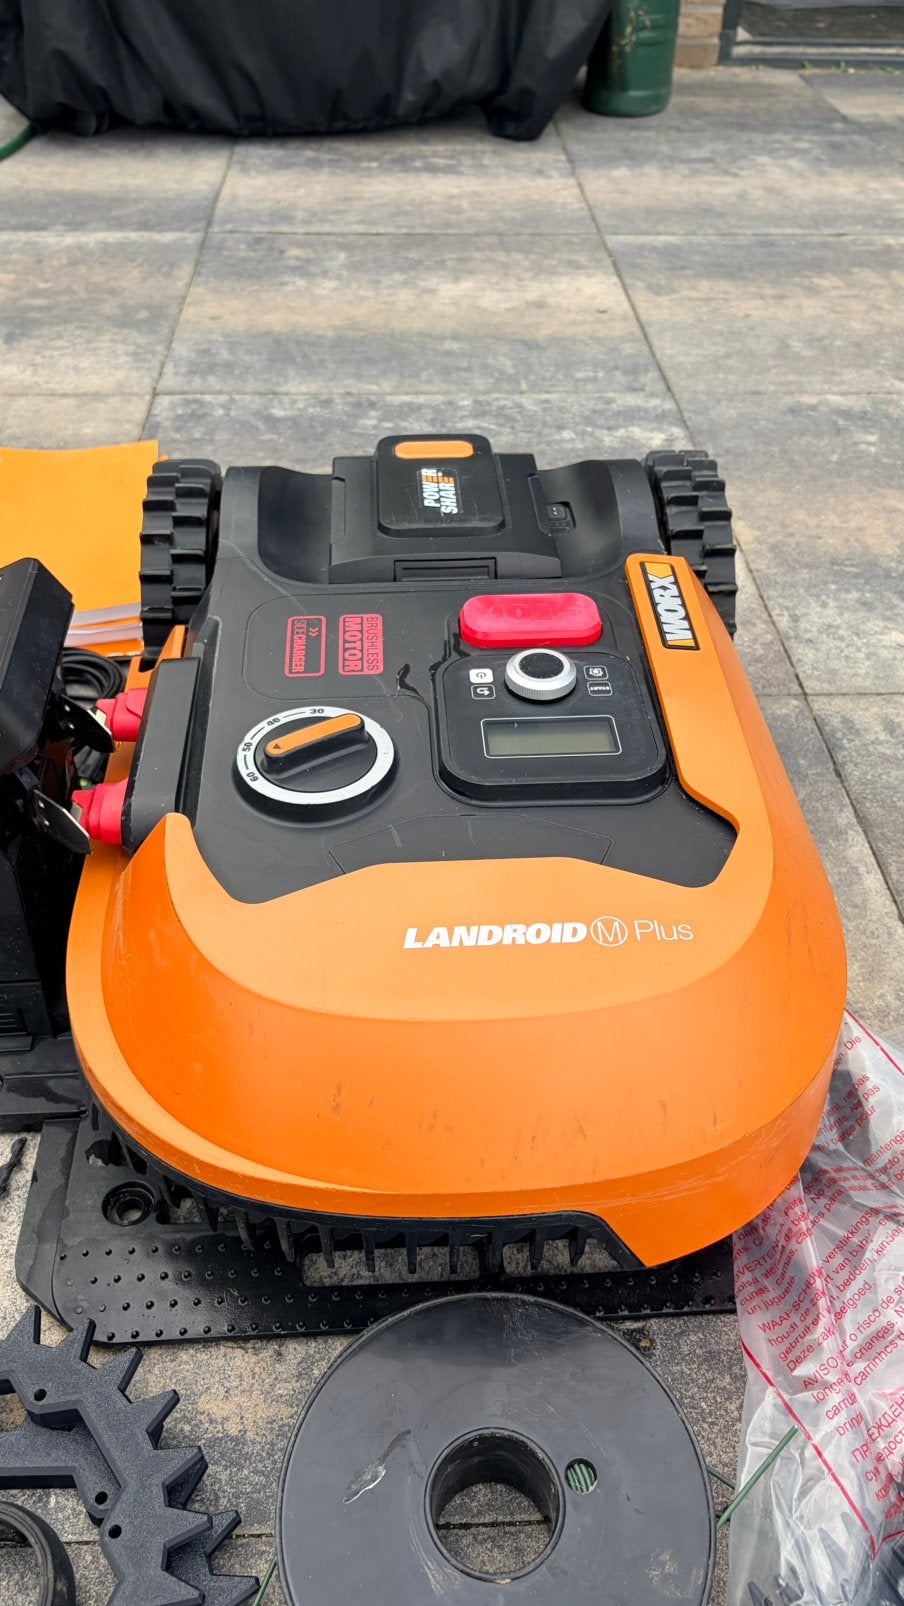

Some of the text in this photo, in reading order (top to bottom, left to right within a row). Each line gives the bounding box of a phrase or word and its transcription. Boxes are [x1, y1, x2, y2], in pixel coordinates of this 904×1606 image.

[421, 469, 440, 507] POWER
[438, 476, 458, 514] SHARE
[648, 574, 693, 640] WORX
[344, 617, 362, 672] MOTOR
[366, 616, 379, 671] BRUSHLESS
[266, 717, 281, 727] 40
[242, 742, 253, 752] 50
[246, 772, 259, 782] 60
[403, 922, 588, 949] LANDROID
[634, 920, 694, 941] Plus
[844, 1036, 862, 1051] Die
[853, 1073, 870, 1092] pas
[862, 1085, 880, 1102] pas
[810, 1188, 825, 1204] No
[824, 1189, 844, 1212] para
[747, 1304, 762, 1315] un
[768, 1321, 798, 1347] houdt
[799, 1307, 811, 1322] de
[832, 1257, 852, 1274] van
[779, 1311, 826, 1361] gebruiken
[835, 1257, 876, 1292] bedden,
[849, 1333, 858, 1341] o
[857, 1309, 881, 1334] risco
[881, 1296, 895, 1309] de
[854, 1321, 898, 1359] crianças.
[786, 1345, 815, 1372] Deze
